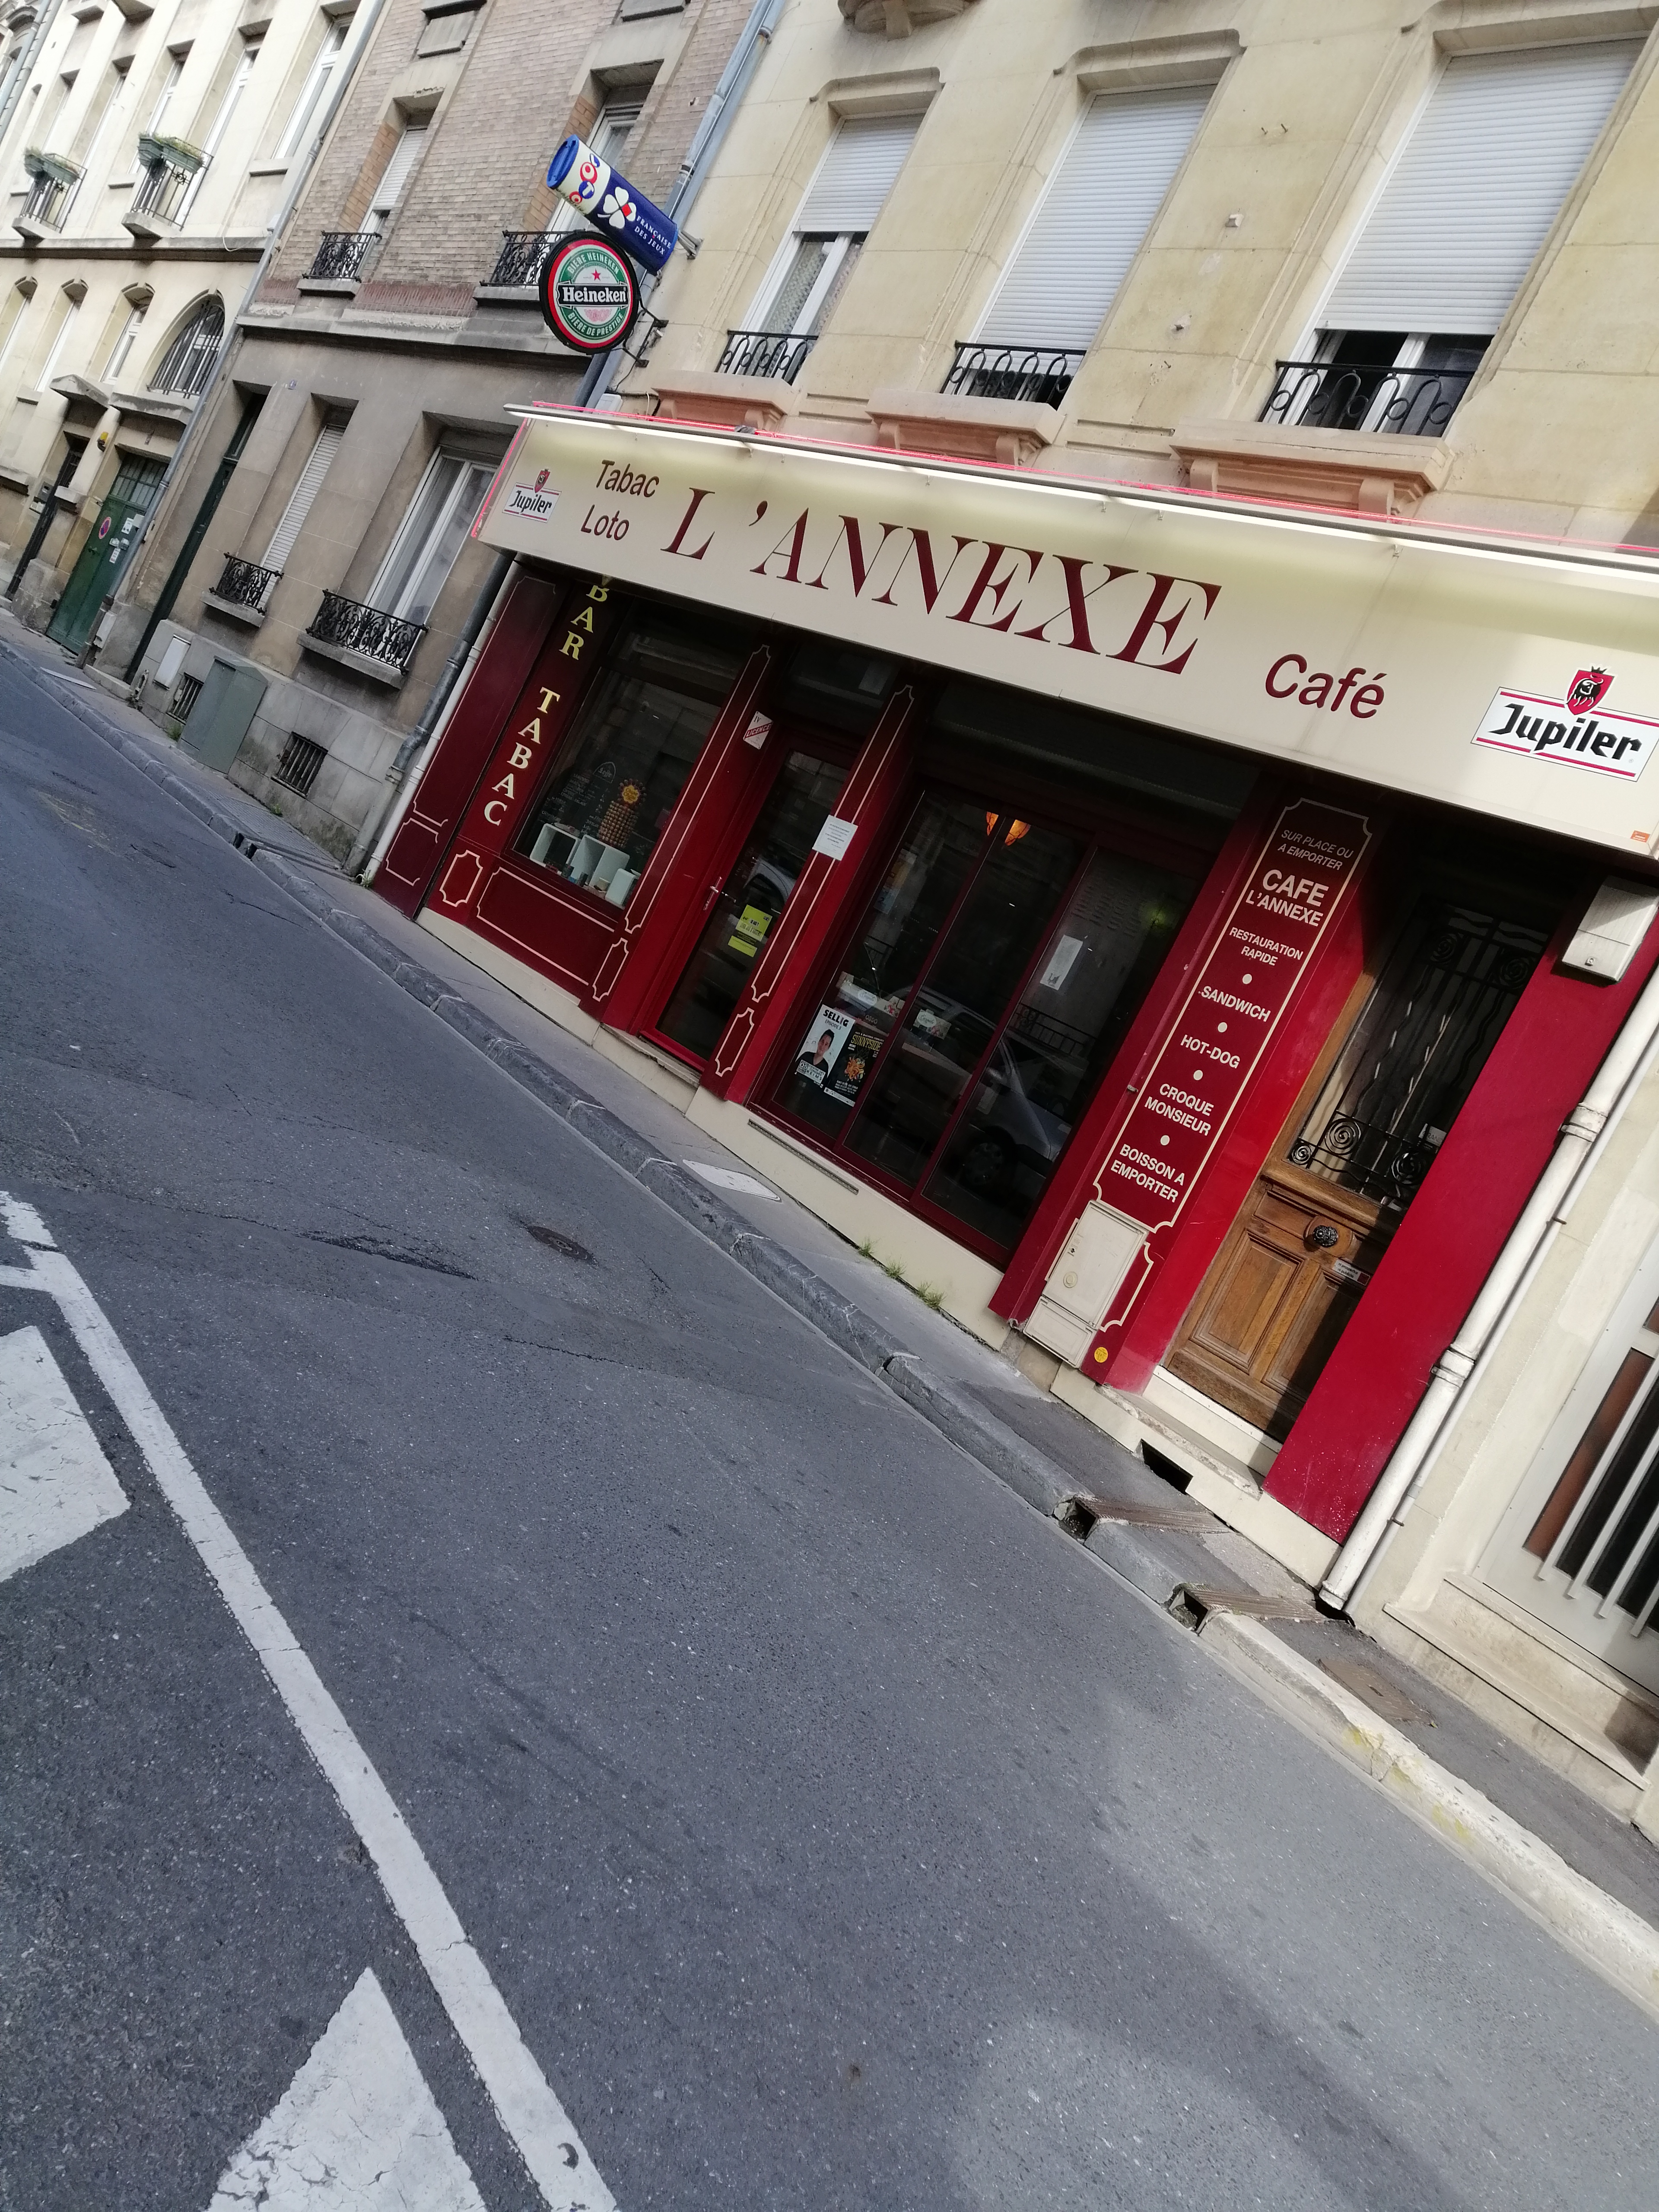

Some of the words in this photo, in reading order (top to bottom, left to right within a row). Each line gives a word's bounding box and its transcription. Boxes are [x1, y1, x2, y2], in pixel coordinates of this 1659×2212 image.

[635, 226, 647, 239] DES
[648, 238, 665, 255] JEUX
[637, 216, 671, 249] FRANÇAISE
[567, 254, 587, 274] BIERE
[586, 251, 620, 275] HEINEKEN
[563, 286, 626, 302] Heineken
[567, 312, 587, 332] BIERE
[586, 327, 595, 336] DE
[596, 312, 623, 336] PRESTIGE
[596, 460, 659, 498] Tabac
[509, 490, 553, 515] Jupiler
[581, 504, 629, 541] Loto
[1265, 653, 1387, 718] Café
[746, 723, 771, 737] LICENCE
[1488, 703, 1642, 760] Jupiler
[484, 686, 560, 826] TABAC
[1278, 843, 1287, 852] A
[1287, 846, 1343, 871] EMPORTER
[1281, 829, 1303, 843] SUR
[1302, 836, 1338, 853] PLACE
[1337, 847, 1354, 859] OU
[1262, 869, 1329, 907] CAFE
[1246, 890, 1324, 927] L'ANNEXE
[1229, 927, 1303, 960] RESTAURATION
[1241, 945, 1278, 966] RAPIDE
[823, 1009, 849, 1027] SELLIG
[1201, 985, 1271, 1022] SANDWICH
[851, 1034, 883, 1052] SUNNYSIDE
[1180, 1034, 1240, 1069] HOT-DOG
[806, 1069, 822, 1081] REIMS
[1144, 1096, 1211, 1136] MONSIEUR
[1160, 1084, 1214, 1116] CROQUE
[1111, 1160, 1179, 1203] EMPORTER
[1119, 1144, 1175, 1180] BOISSON
[1174, 1173, 1185, 1186] A
